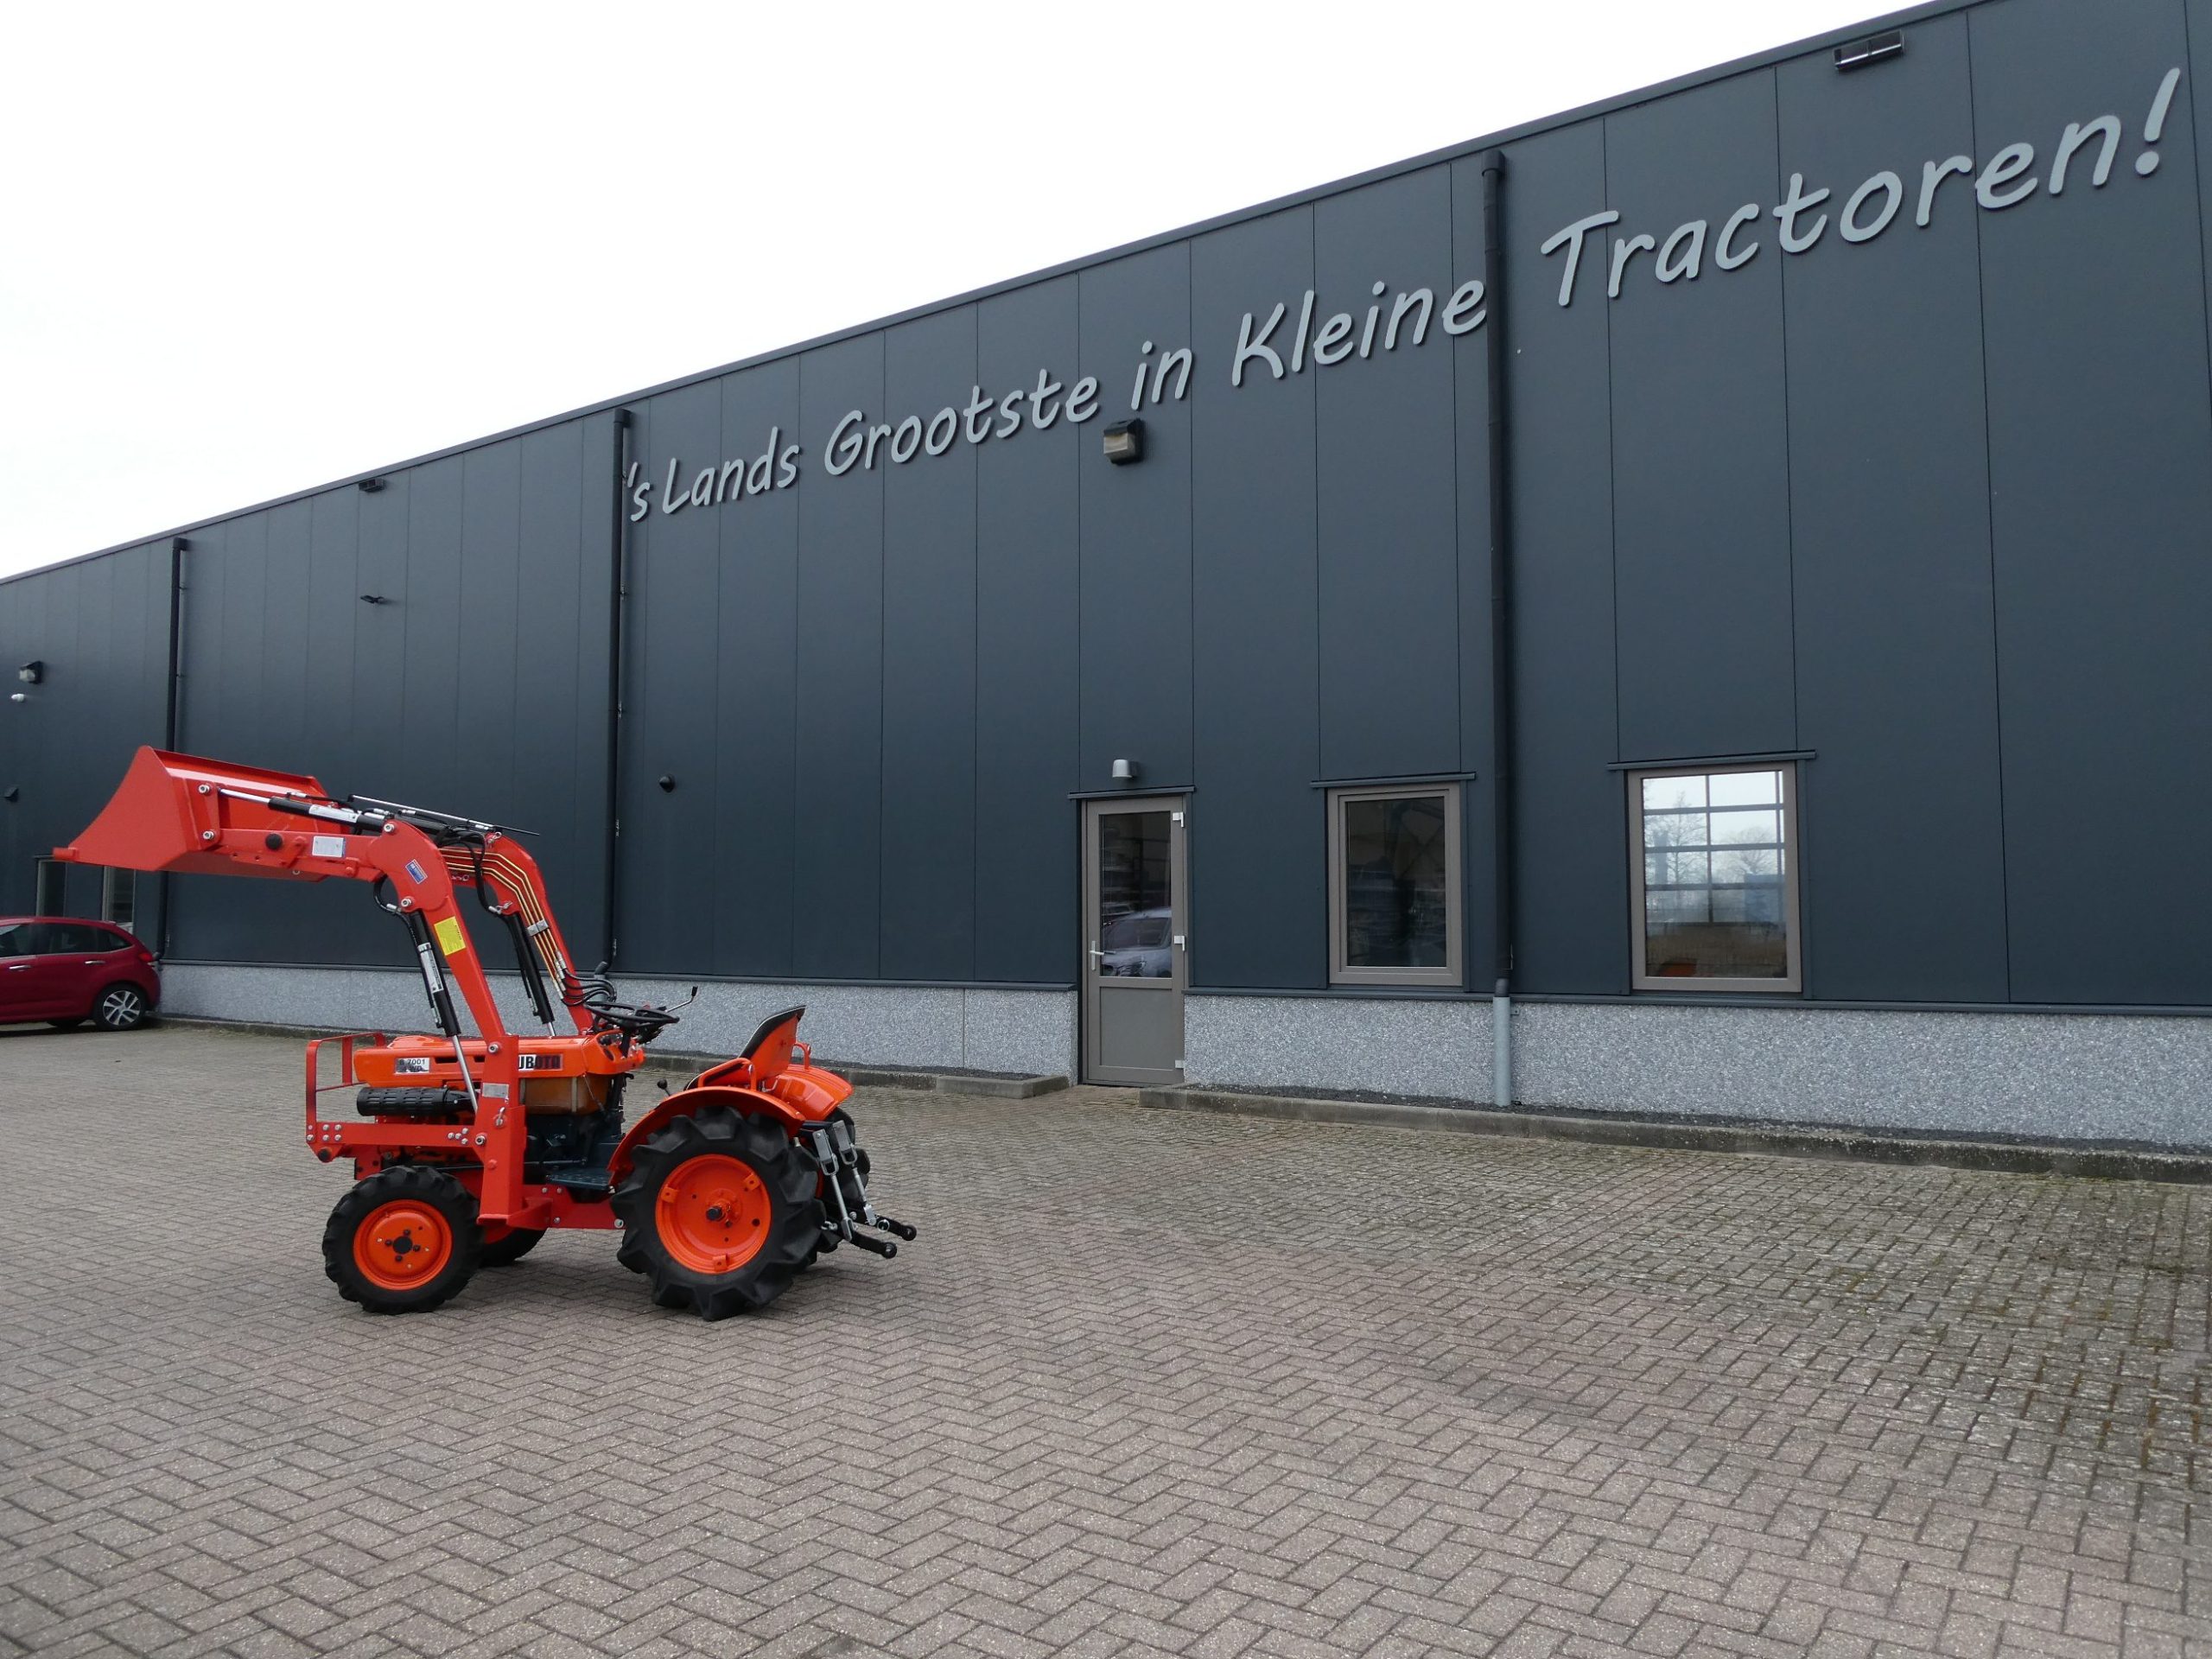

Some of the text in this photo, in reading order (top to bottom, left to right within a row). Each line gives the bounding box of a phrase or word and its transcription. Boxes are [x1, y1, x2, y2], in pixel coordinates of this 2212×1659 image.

[627, 67, 2182, 522] 's Lands Grootste in Kleine Tractoren!
[518, 1055, 561, 1070] UBOTA
